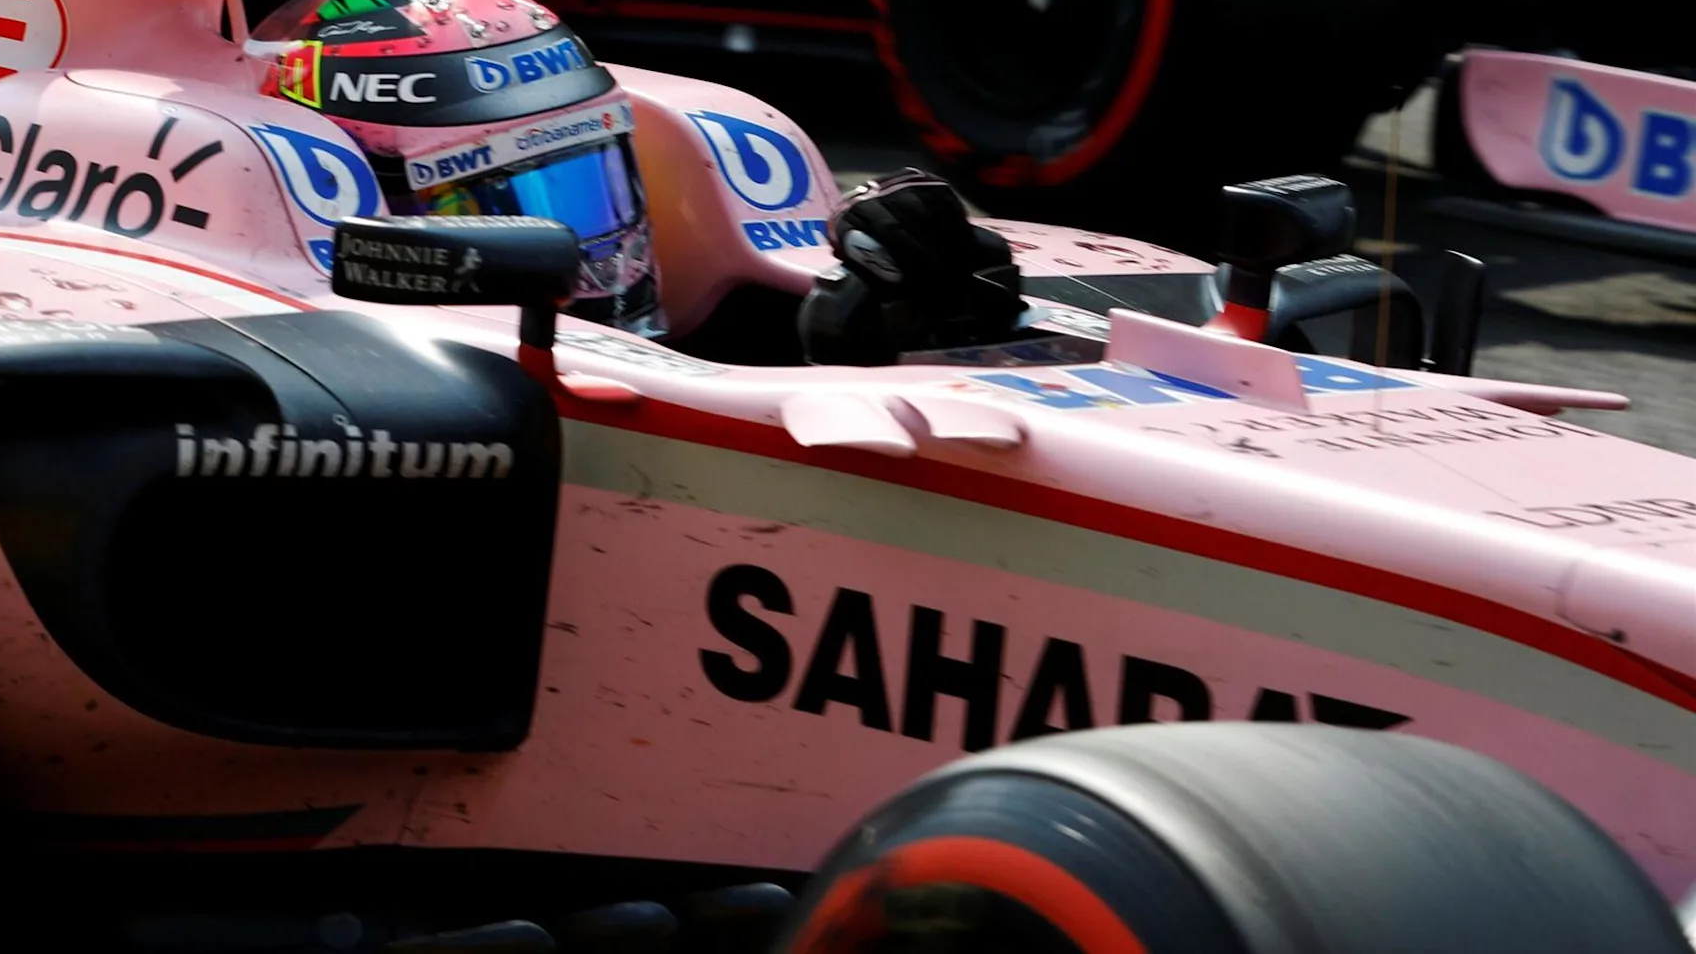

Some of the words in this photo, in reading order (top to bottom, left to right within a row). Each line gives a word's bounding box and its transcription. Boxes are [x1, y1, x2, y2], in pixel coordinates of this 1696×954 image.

[513, 39, 586, 84] BWT
[330, 72, 437, 103] NEC
[434, 146, 493, 178] BWT
[337, 232, 450, 266] JOHNNIE
[343, 262, 448, 293] WALKER
[177, 422, 512, 479] infinitum
